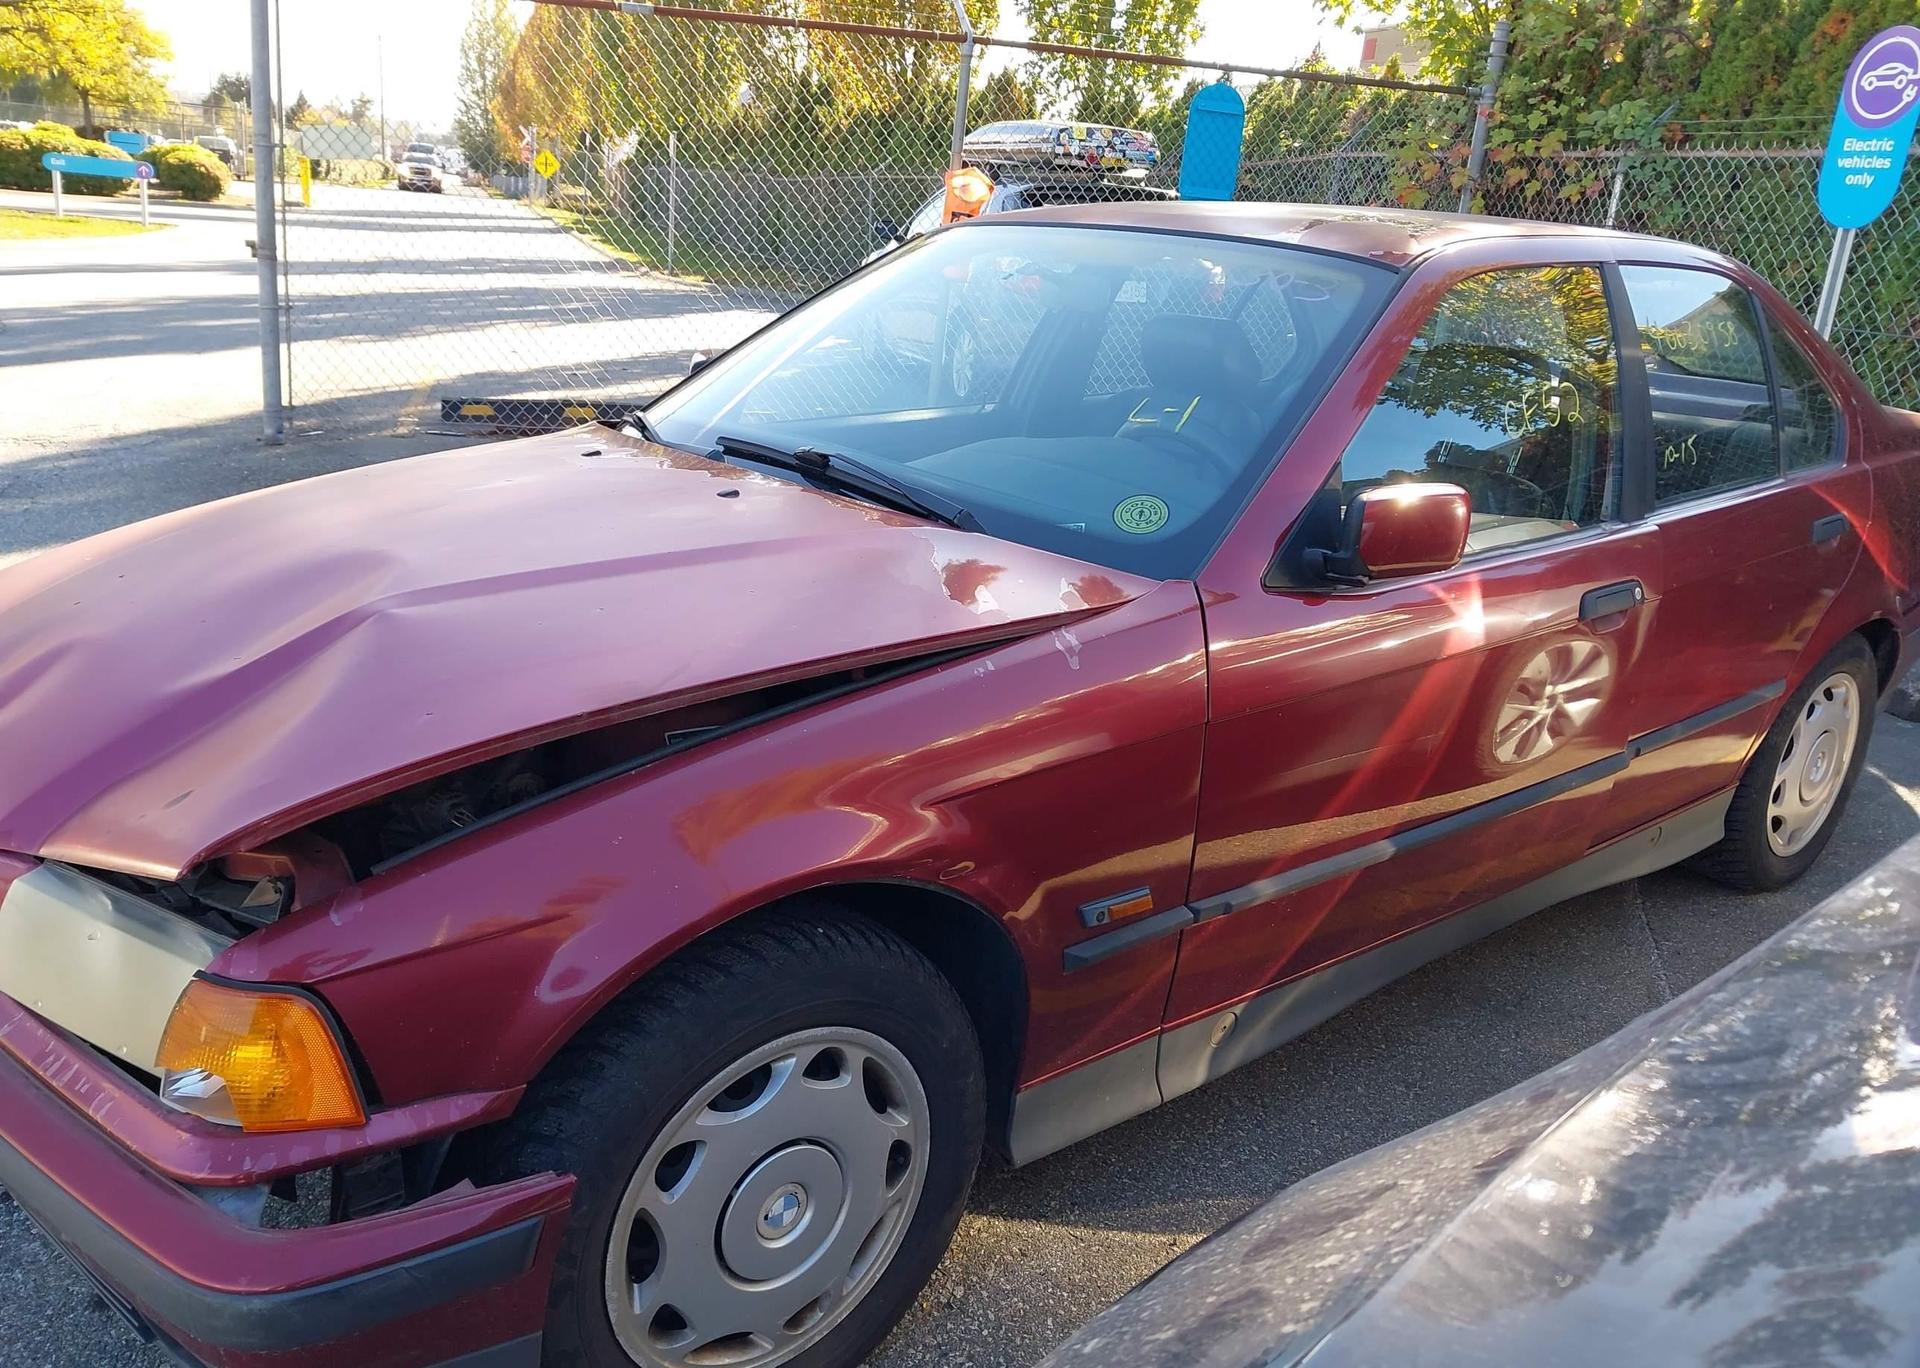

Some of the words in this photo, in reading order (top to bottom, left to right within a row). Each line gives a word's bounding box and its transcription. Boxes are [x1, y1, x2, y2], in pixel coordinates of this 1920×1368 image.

[1843, 137, 1895, 152] Electric
[1837, 154, 1892, 169] vehicles
[1845, 172, 1875, 189] only
